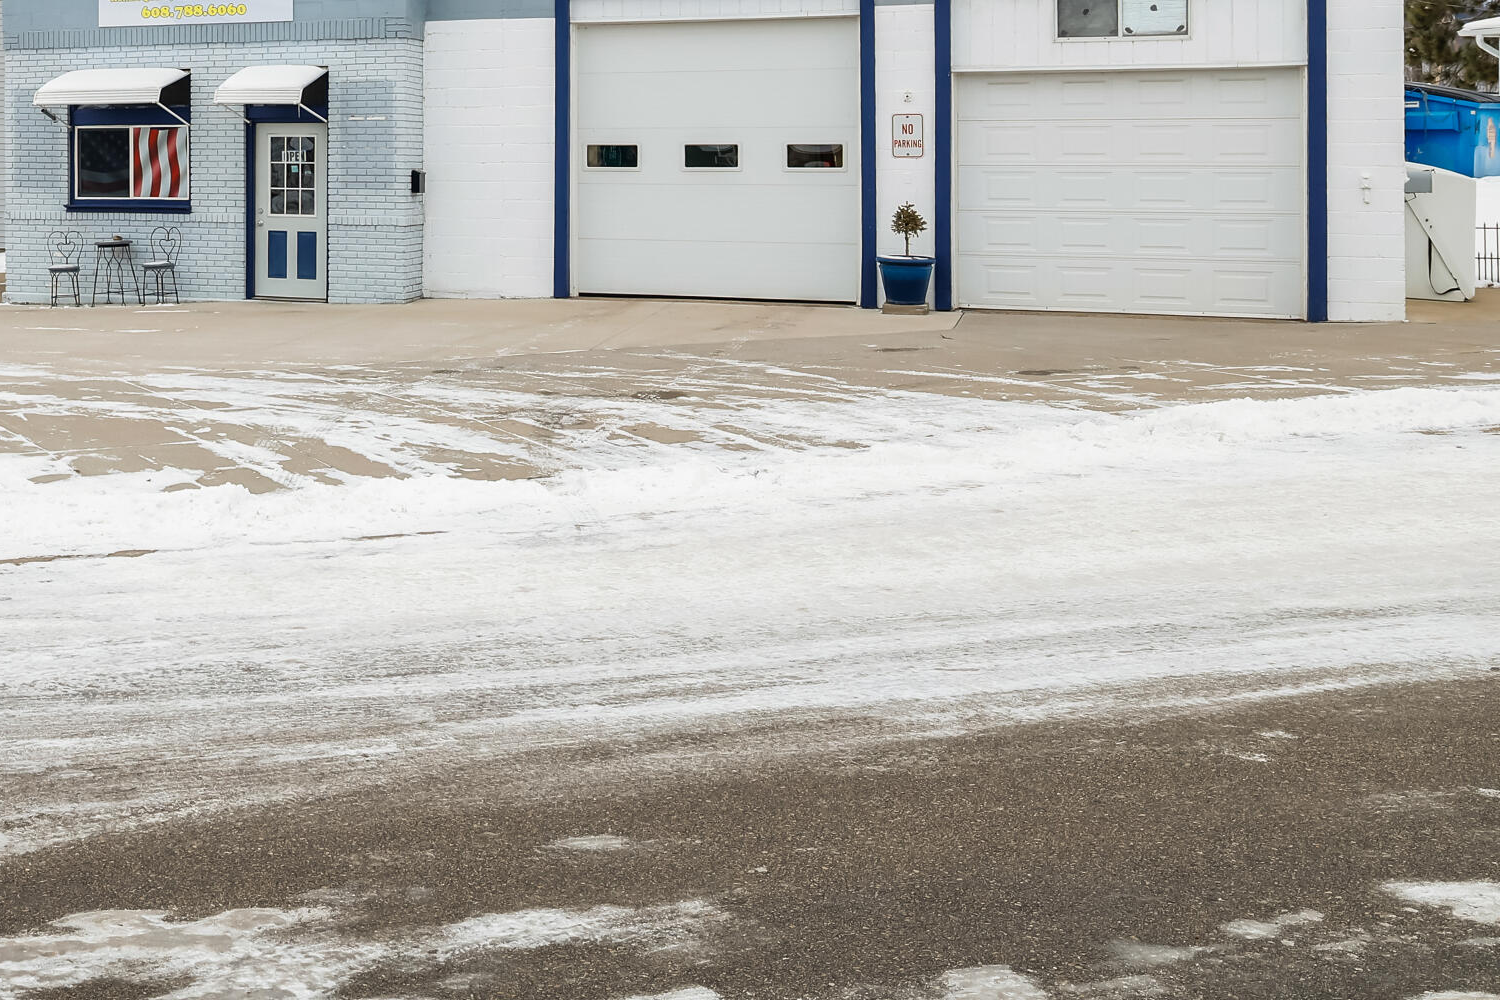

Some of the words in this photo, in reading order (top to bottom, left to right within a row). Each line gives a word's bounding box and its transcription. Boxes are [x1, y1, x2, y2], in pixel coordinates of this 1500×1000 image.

[141, 3, 247, 19] 608.788.6060
[902, 123, 914, 135] NO
[894, 139, 922, 148] PARKING
[283, 151, 305, 161] OPEN
